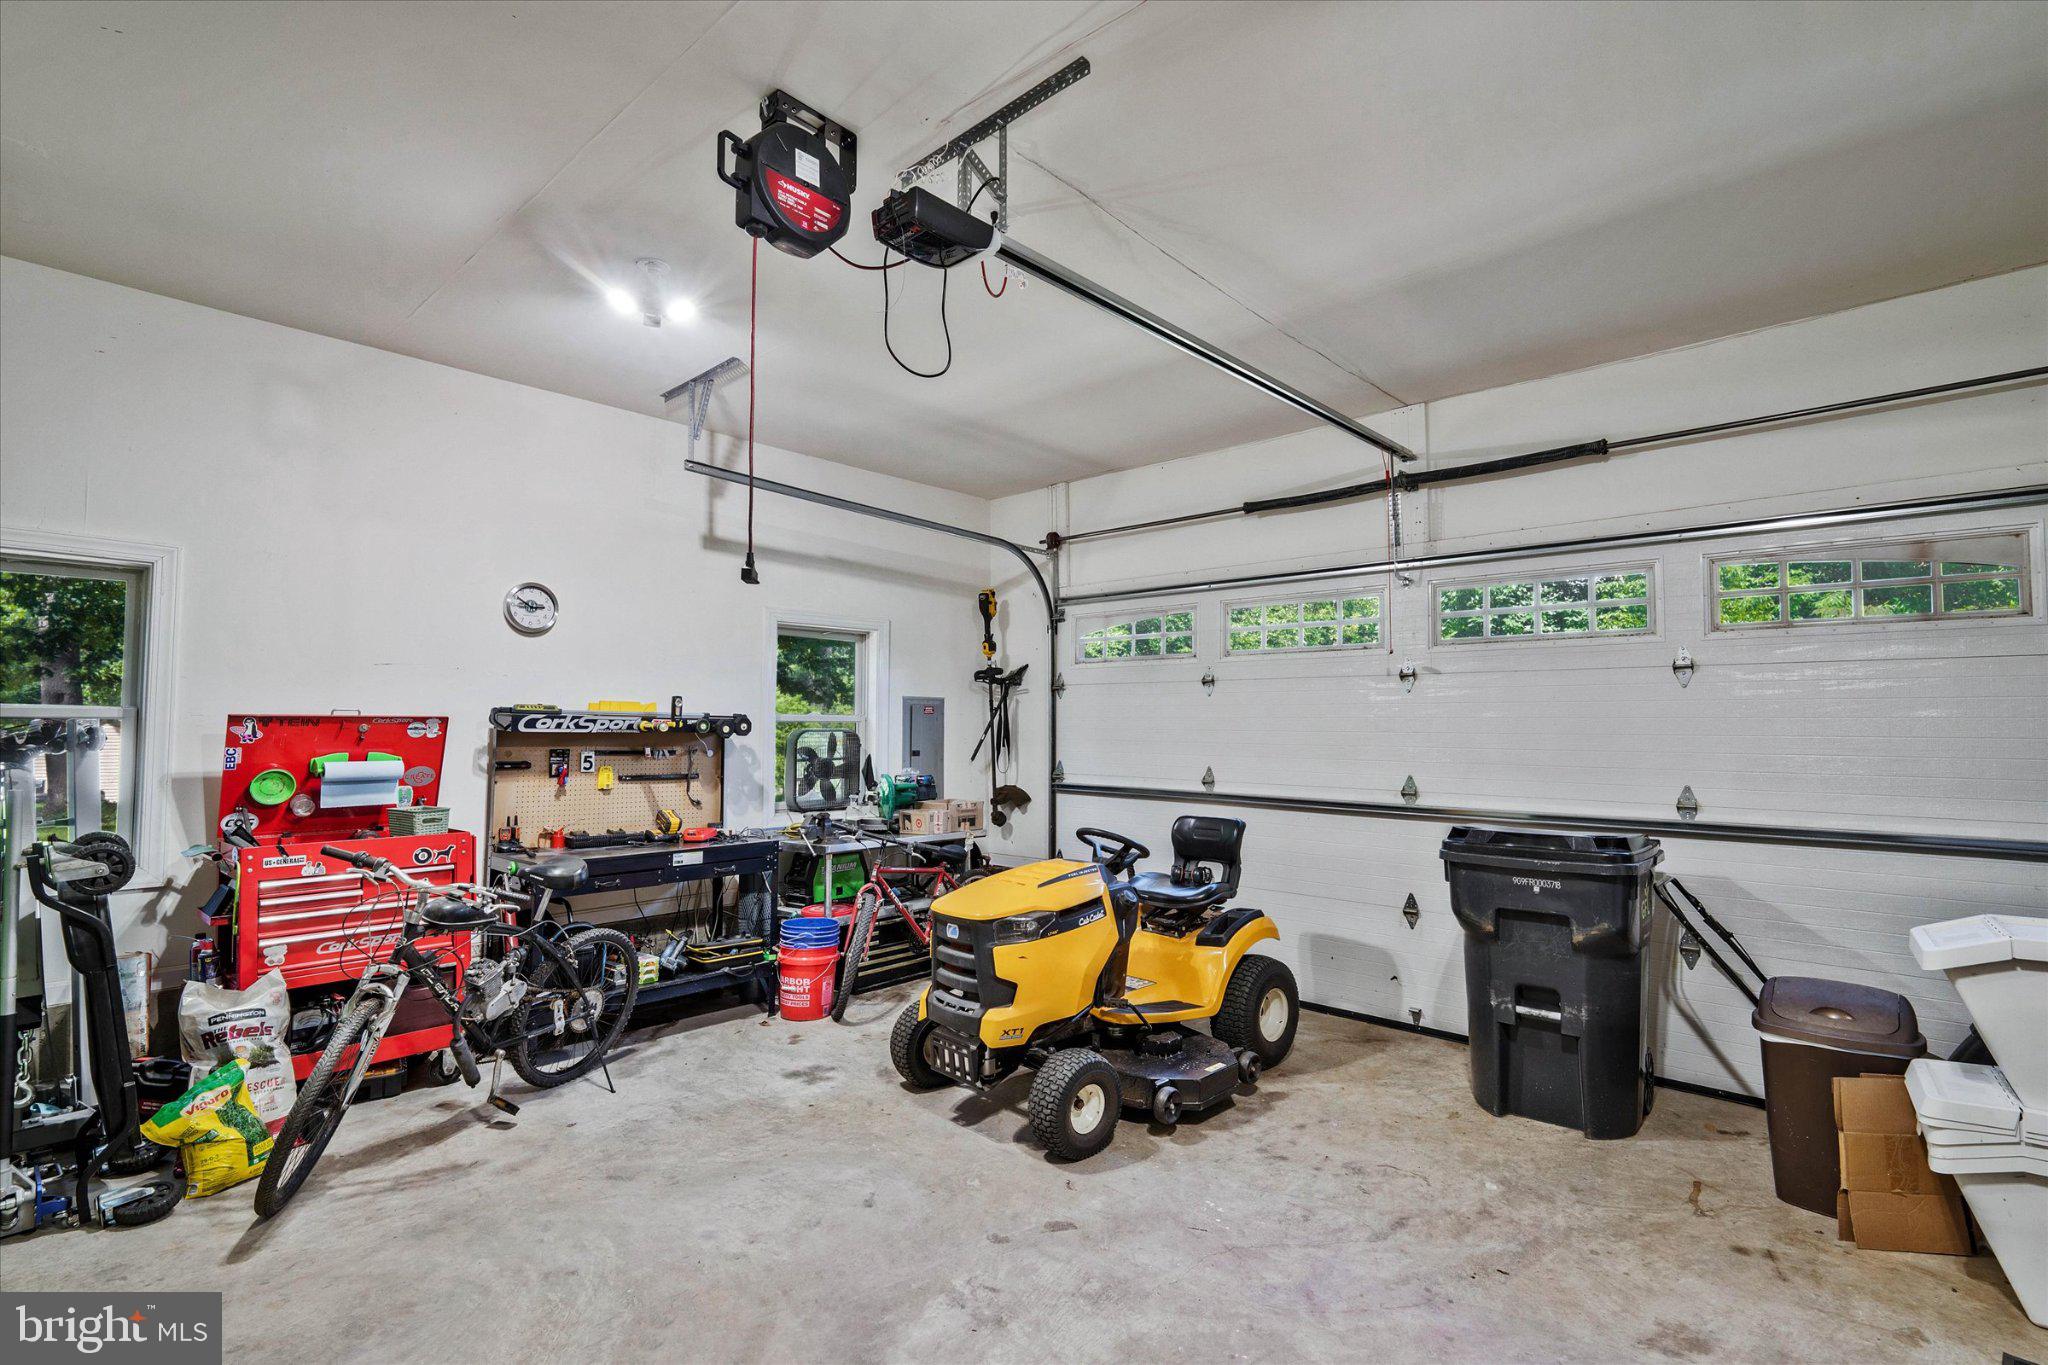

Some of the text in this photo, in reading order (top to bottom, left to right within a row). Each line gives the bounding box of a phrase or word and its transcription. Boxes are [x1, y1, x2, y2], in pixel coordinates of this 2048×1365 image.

[225, 748, 237, 769] EBC
[582, 755, 594, 771] 5
[264, 859, 273, 867] US
[1079, 909, 1104, 926] Cub Cadet
[211, 1010, 265, 1024] PENNINGTON
[201, 1021, 274, 1050] Rebels
[1001, 1027, 1024, 1036] XT1
[246, 1077, 279, 1092] ESCUE
